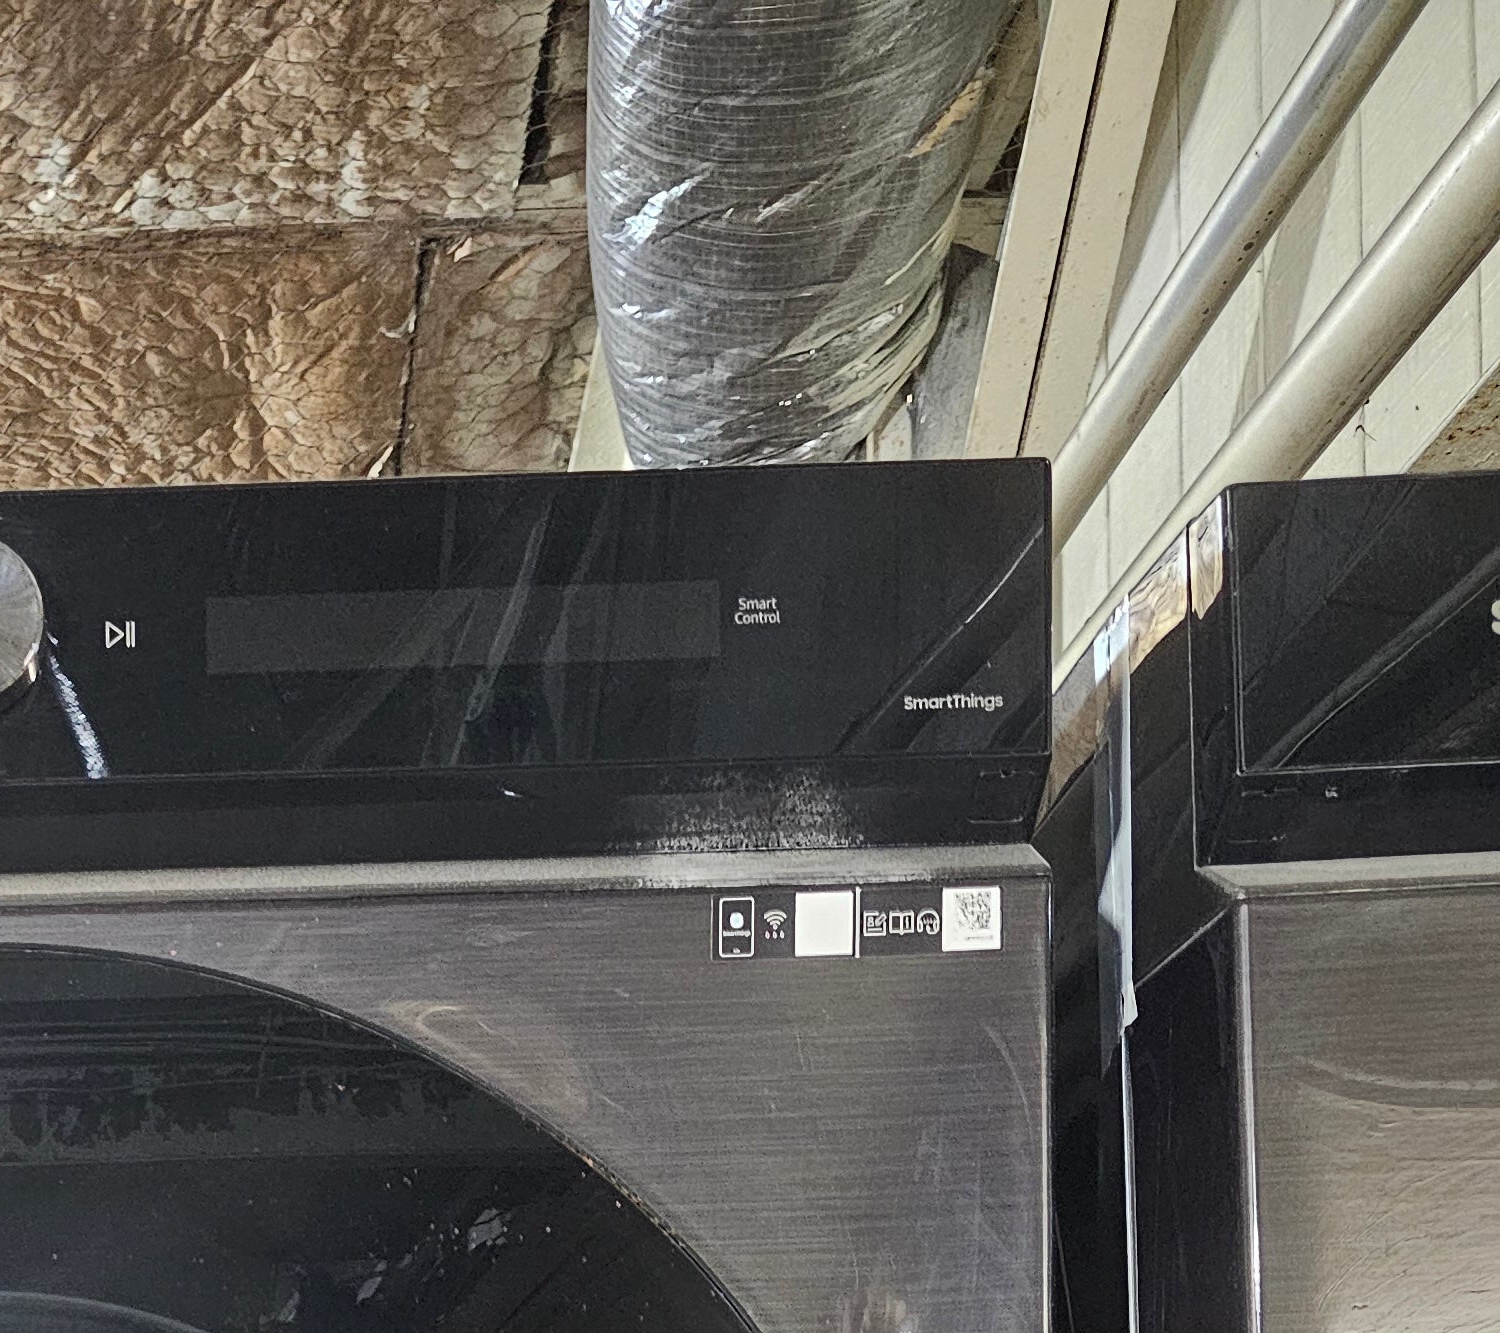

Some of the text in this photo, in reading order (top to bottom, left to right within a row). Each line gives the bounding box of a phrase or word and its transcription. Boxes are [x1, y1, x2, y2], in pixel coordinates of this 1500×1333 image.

[738, 597, 776, 611] Smart
[734, 611, 781, 625] Control
[904, 693, 1003, 712] SmartThings
